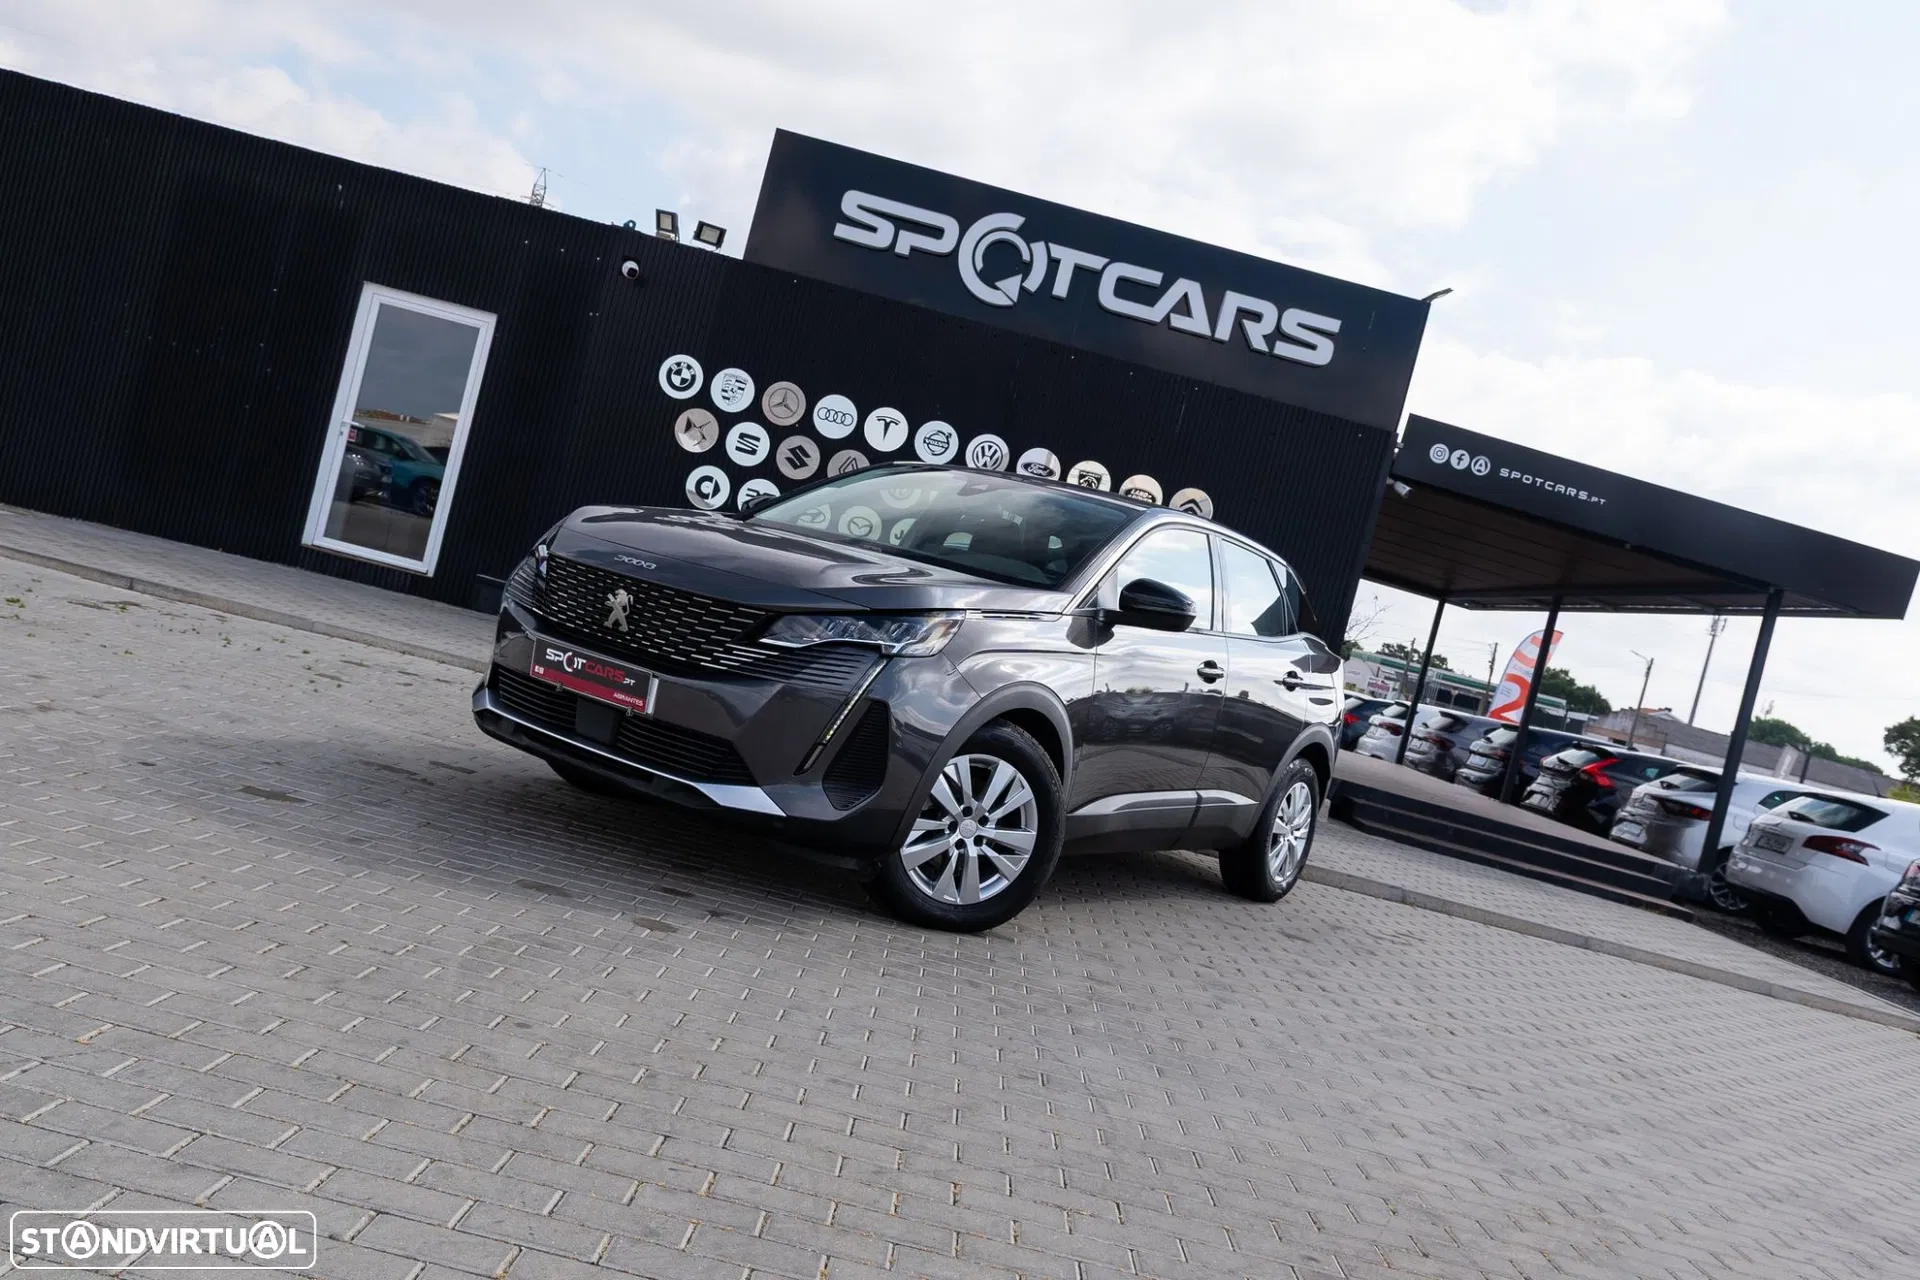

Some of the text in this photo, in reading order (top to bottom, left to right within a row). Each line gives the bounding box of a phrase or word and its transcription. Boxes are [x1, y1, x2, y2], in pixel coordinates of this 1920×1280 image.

[833, 189, 1342, 367] SPOTCARS
[670, 361, 696, 376] BMW
[925, 438, 949, 448] VOLVO
[1027, 463, 1051, 476] Ford
[1499, 467, 1606, 506] SPOTCARS.PT
